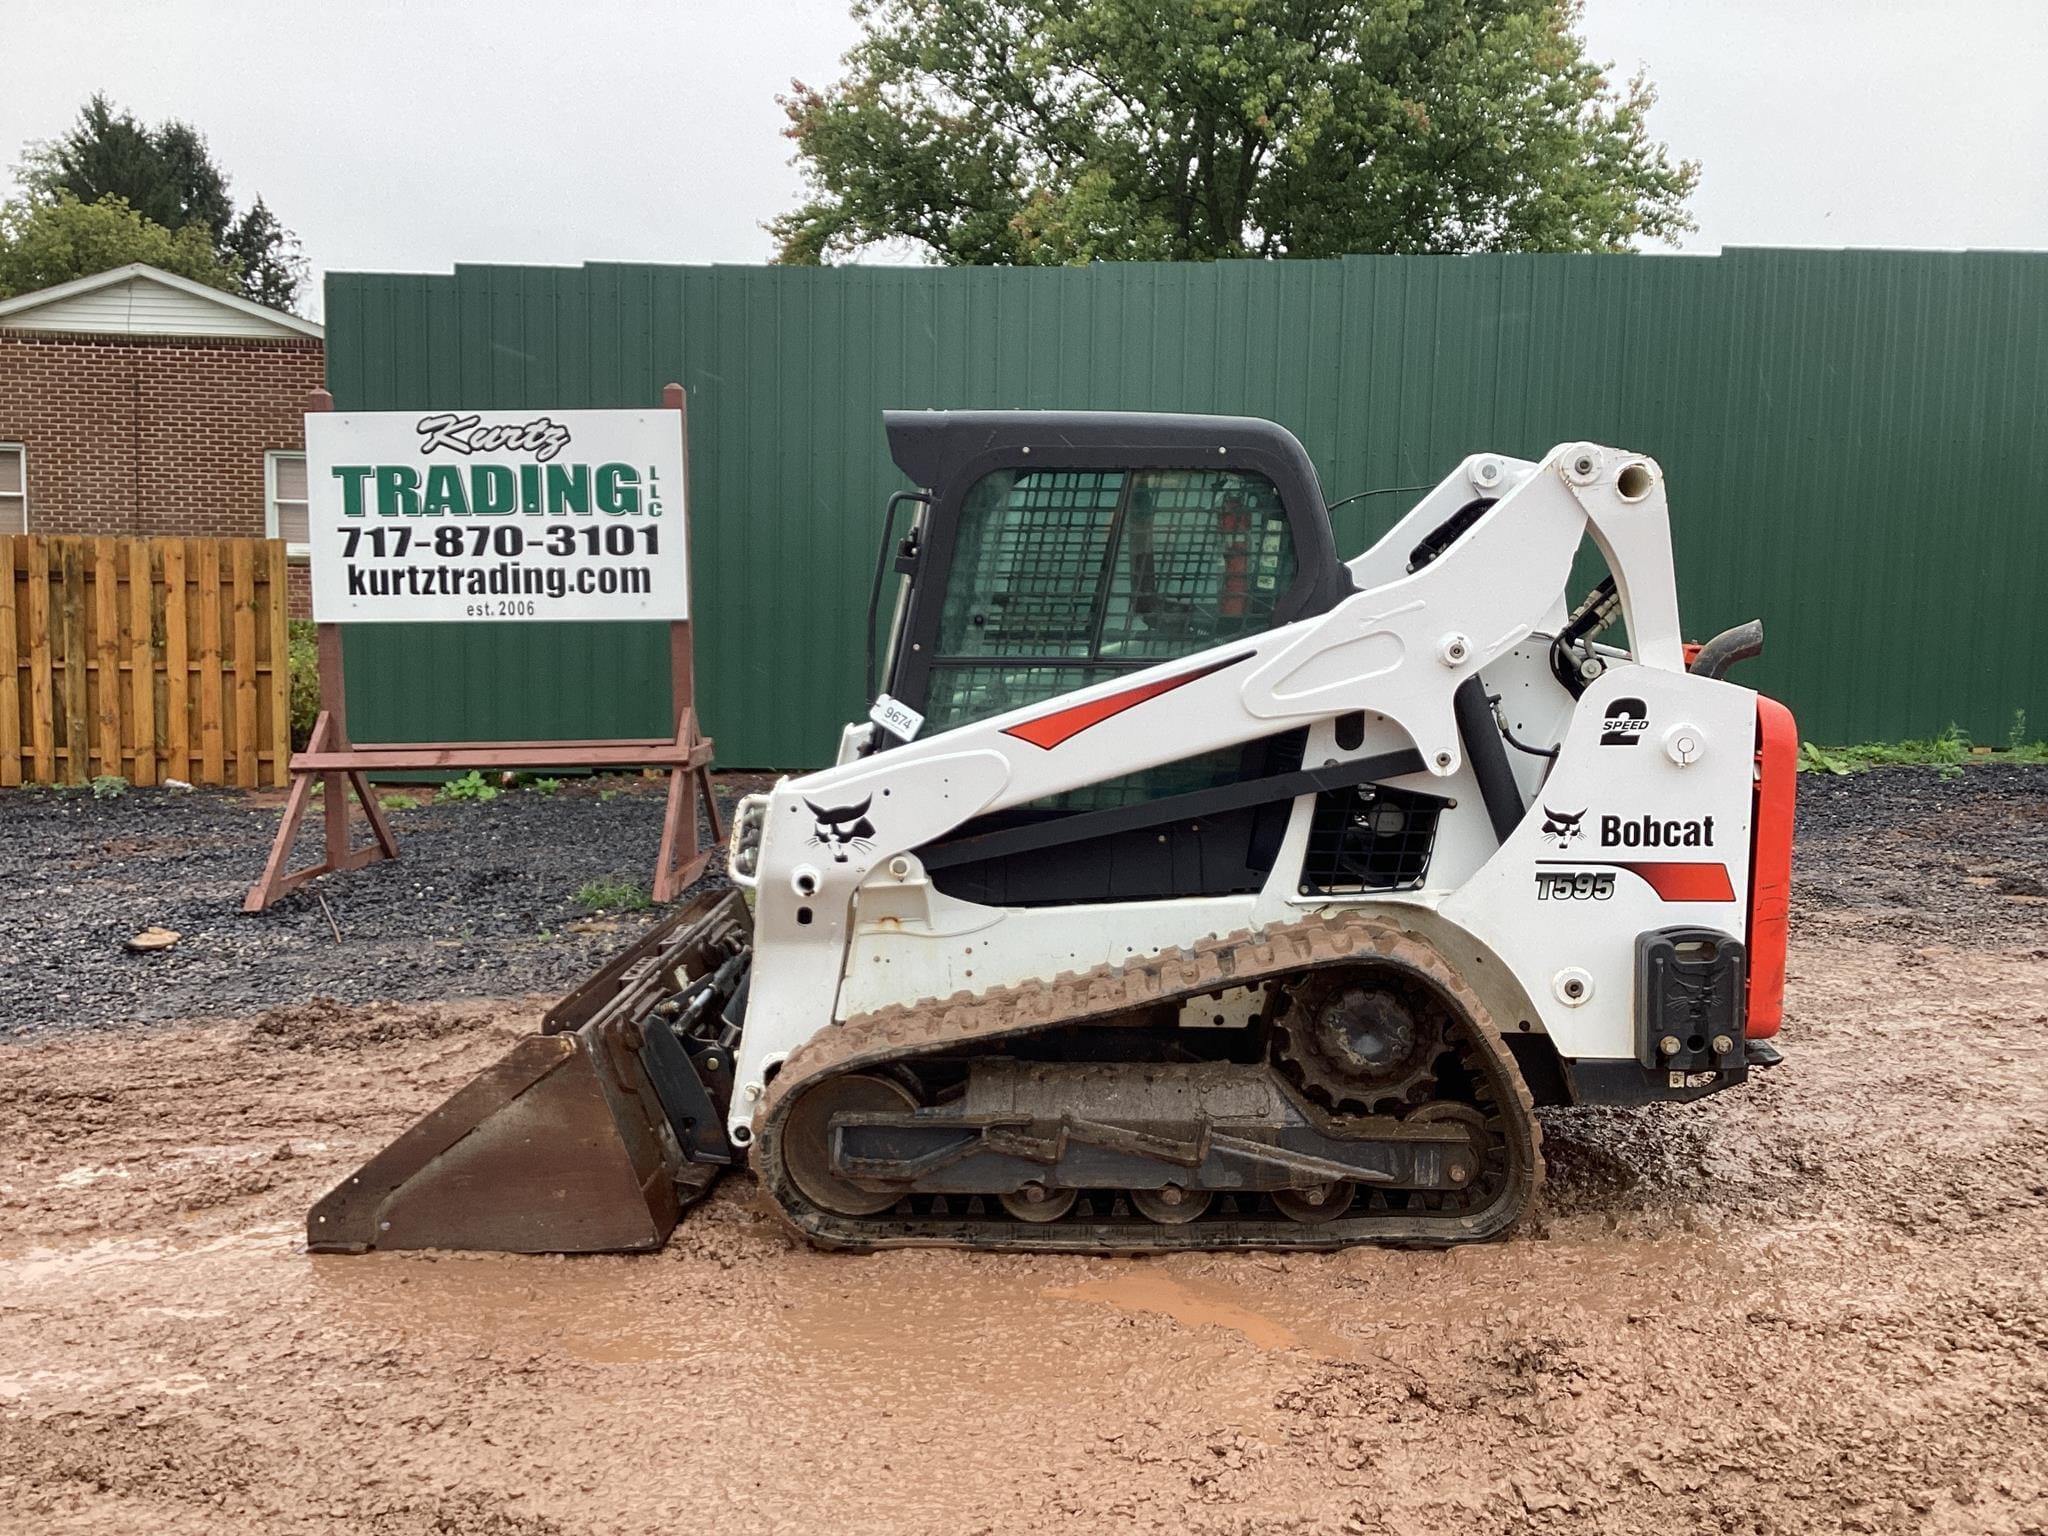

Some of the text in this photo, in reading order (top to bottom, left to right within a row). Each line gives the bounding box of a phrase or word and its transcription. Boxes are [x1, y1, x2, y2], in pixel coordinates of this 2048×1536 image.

[417, 414, 571, 462] Kurtz
[331, 463, 643, 517] TRADING
[648, 465, 663, 517] LLC
[337, 524, 659, 558] 717-870-3101
[348, 562, 651, 598] kurtztrading.com
[467, 601, 535, 617] est. 2006
[884, 706, 912, 729] 9674
[1600, 697, 1648, 746] 2
[1602, 720, 1649, 731] SPEED
[1601, 814, 1714, 847] Bobcat
[1535, 872, 1616, 900] T595
